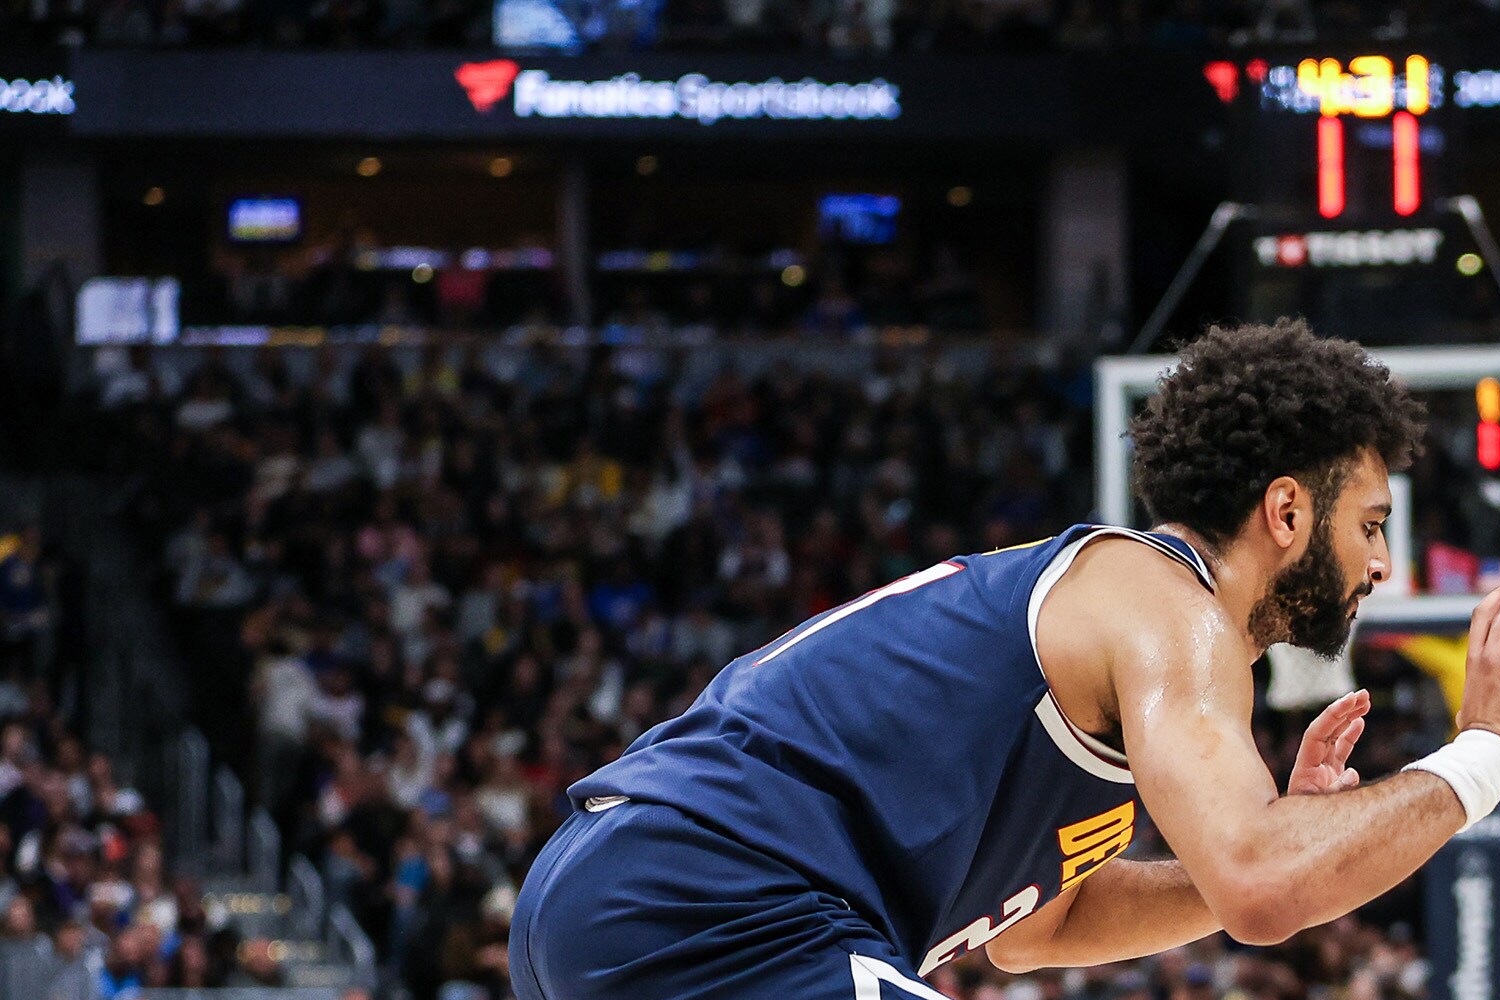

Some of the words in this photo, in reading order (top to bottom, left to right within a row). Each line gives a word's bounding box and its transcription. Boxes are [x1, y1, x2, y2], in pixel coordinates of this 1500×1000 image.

[514, 69, 676, 118] Fanatics
[676, 73, 900, 126] Sportsbook
[1057, 799, 1136, 892] DE
